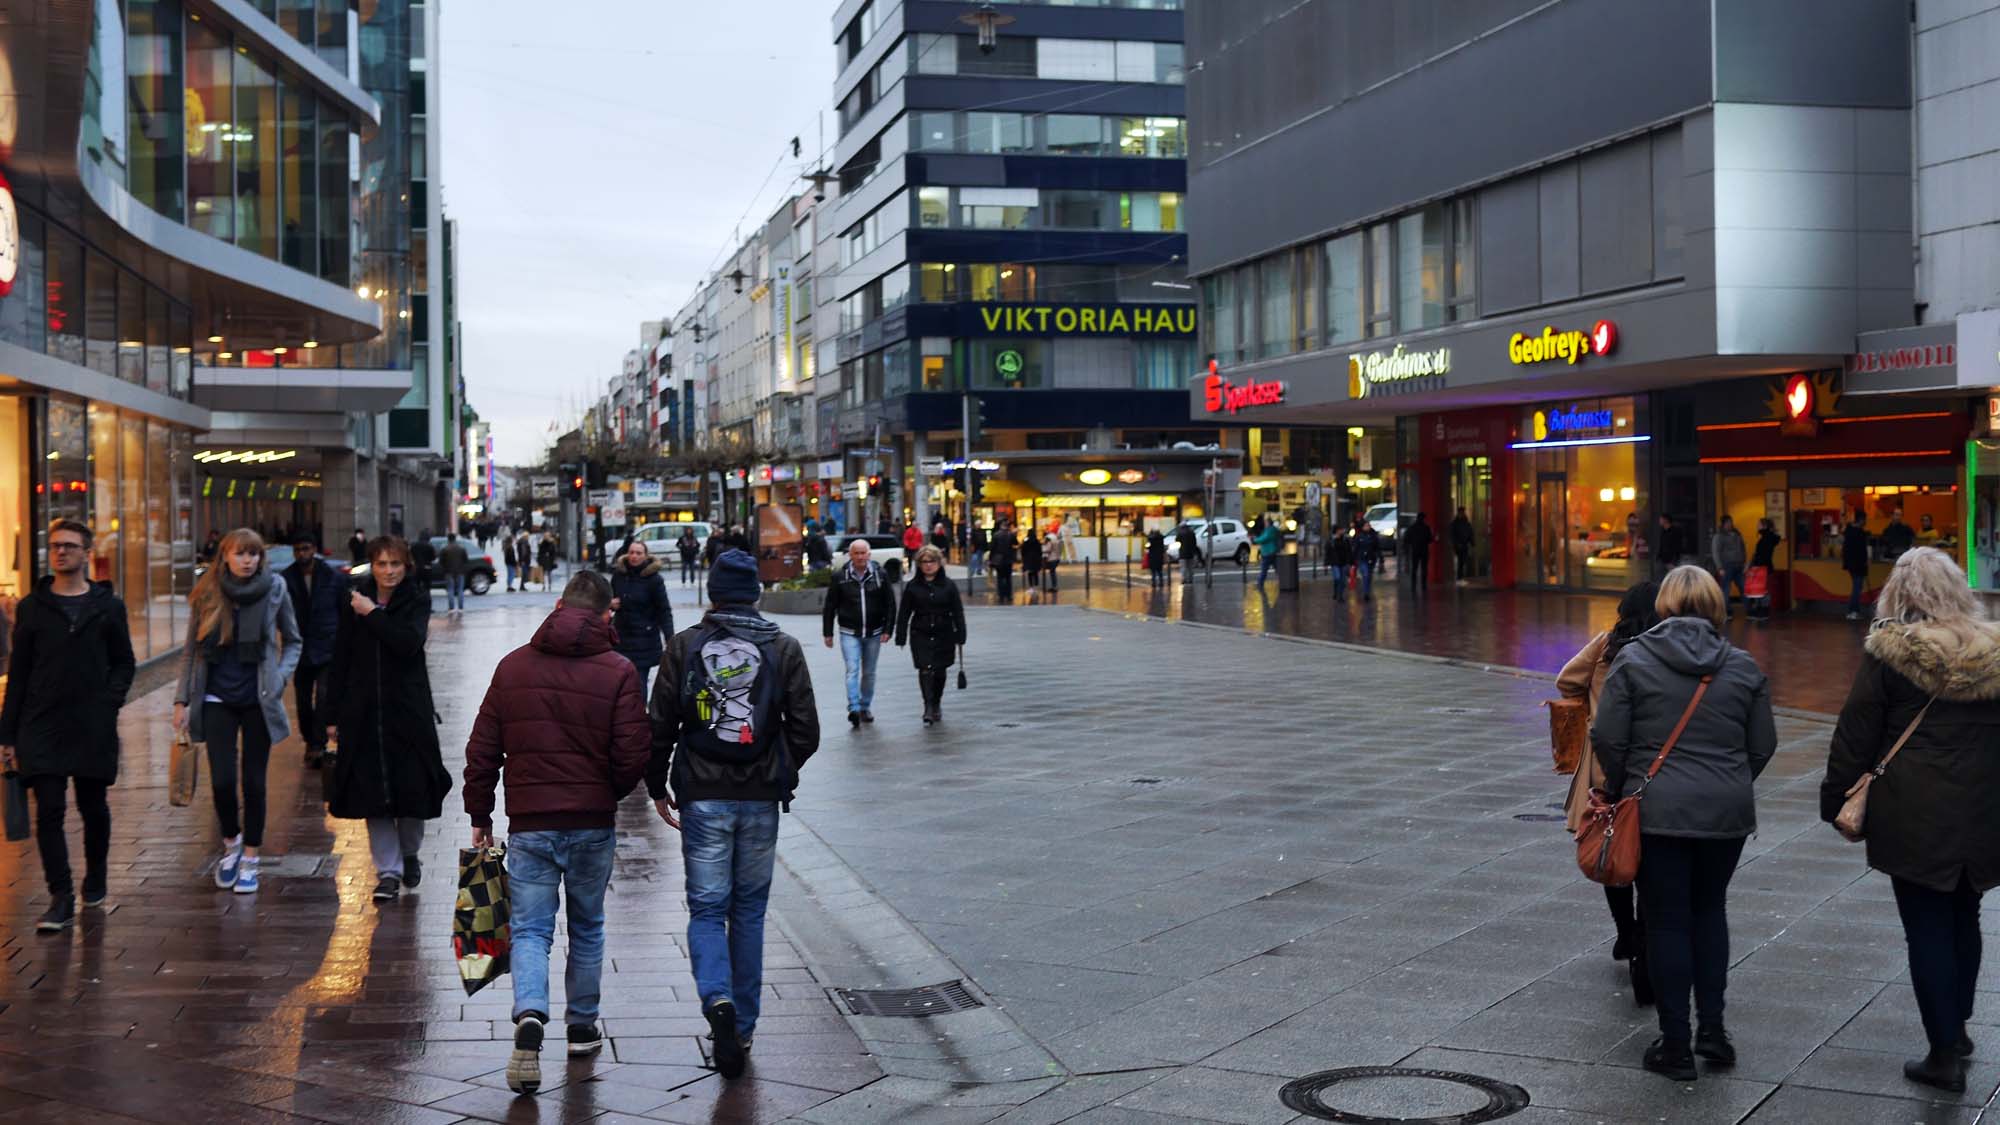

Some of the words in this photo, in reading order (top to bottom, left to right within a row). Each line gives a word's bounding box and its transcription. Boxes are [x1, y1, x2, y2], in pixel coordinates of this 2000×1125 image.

[1509, 326, 1589, 365] Geofrey's
[1224, 378, 1284, 415] Sparkasse
[1550, 403, 1612, 430] Barbarossa
